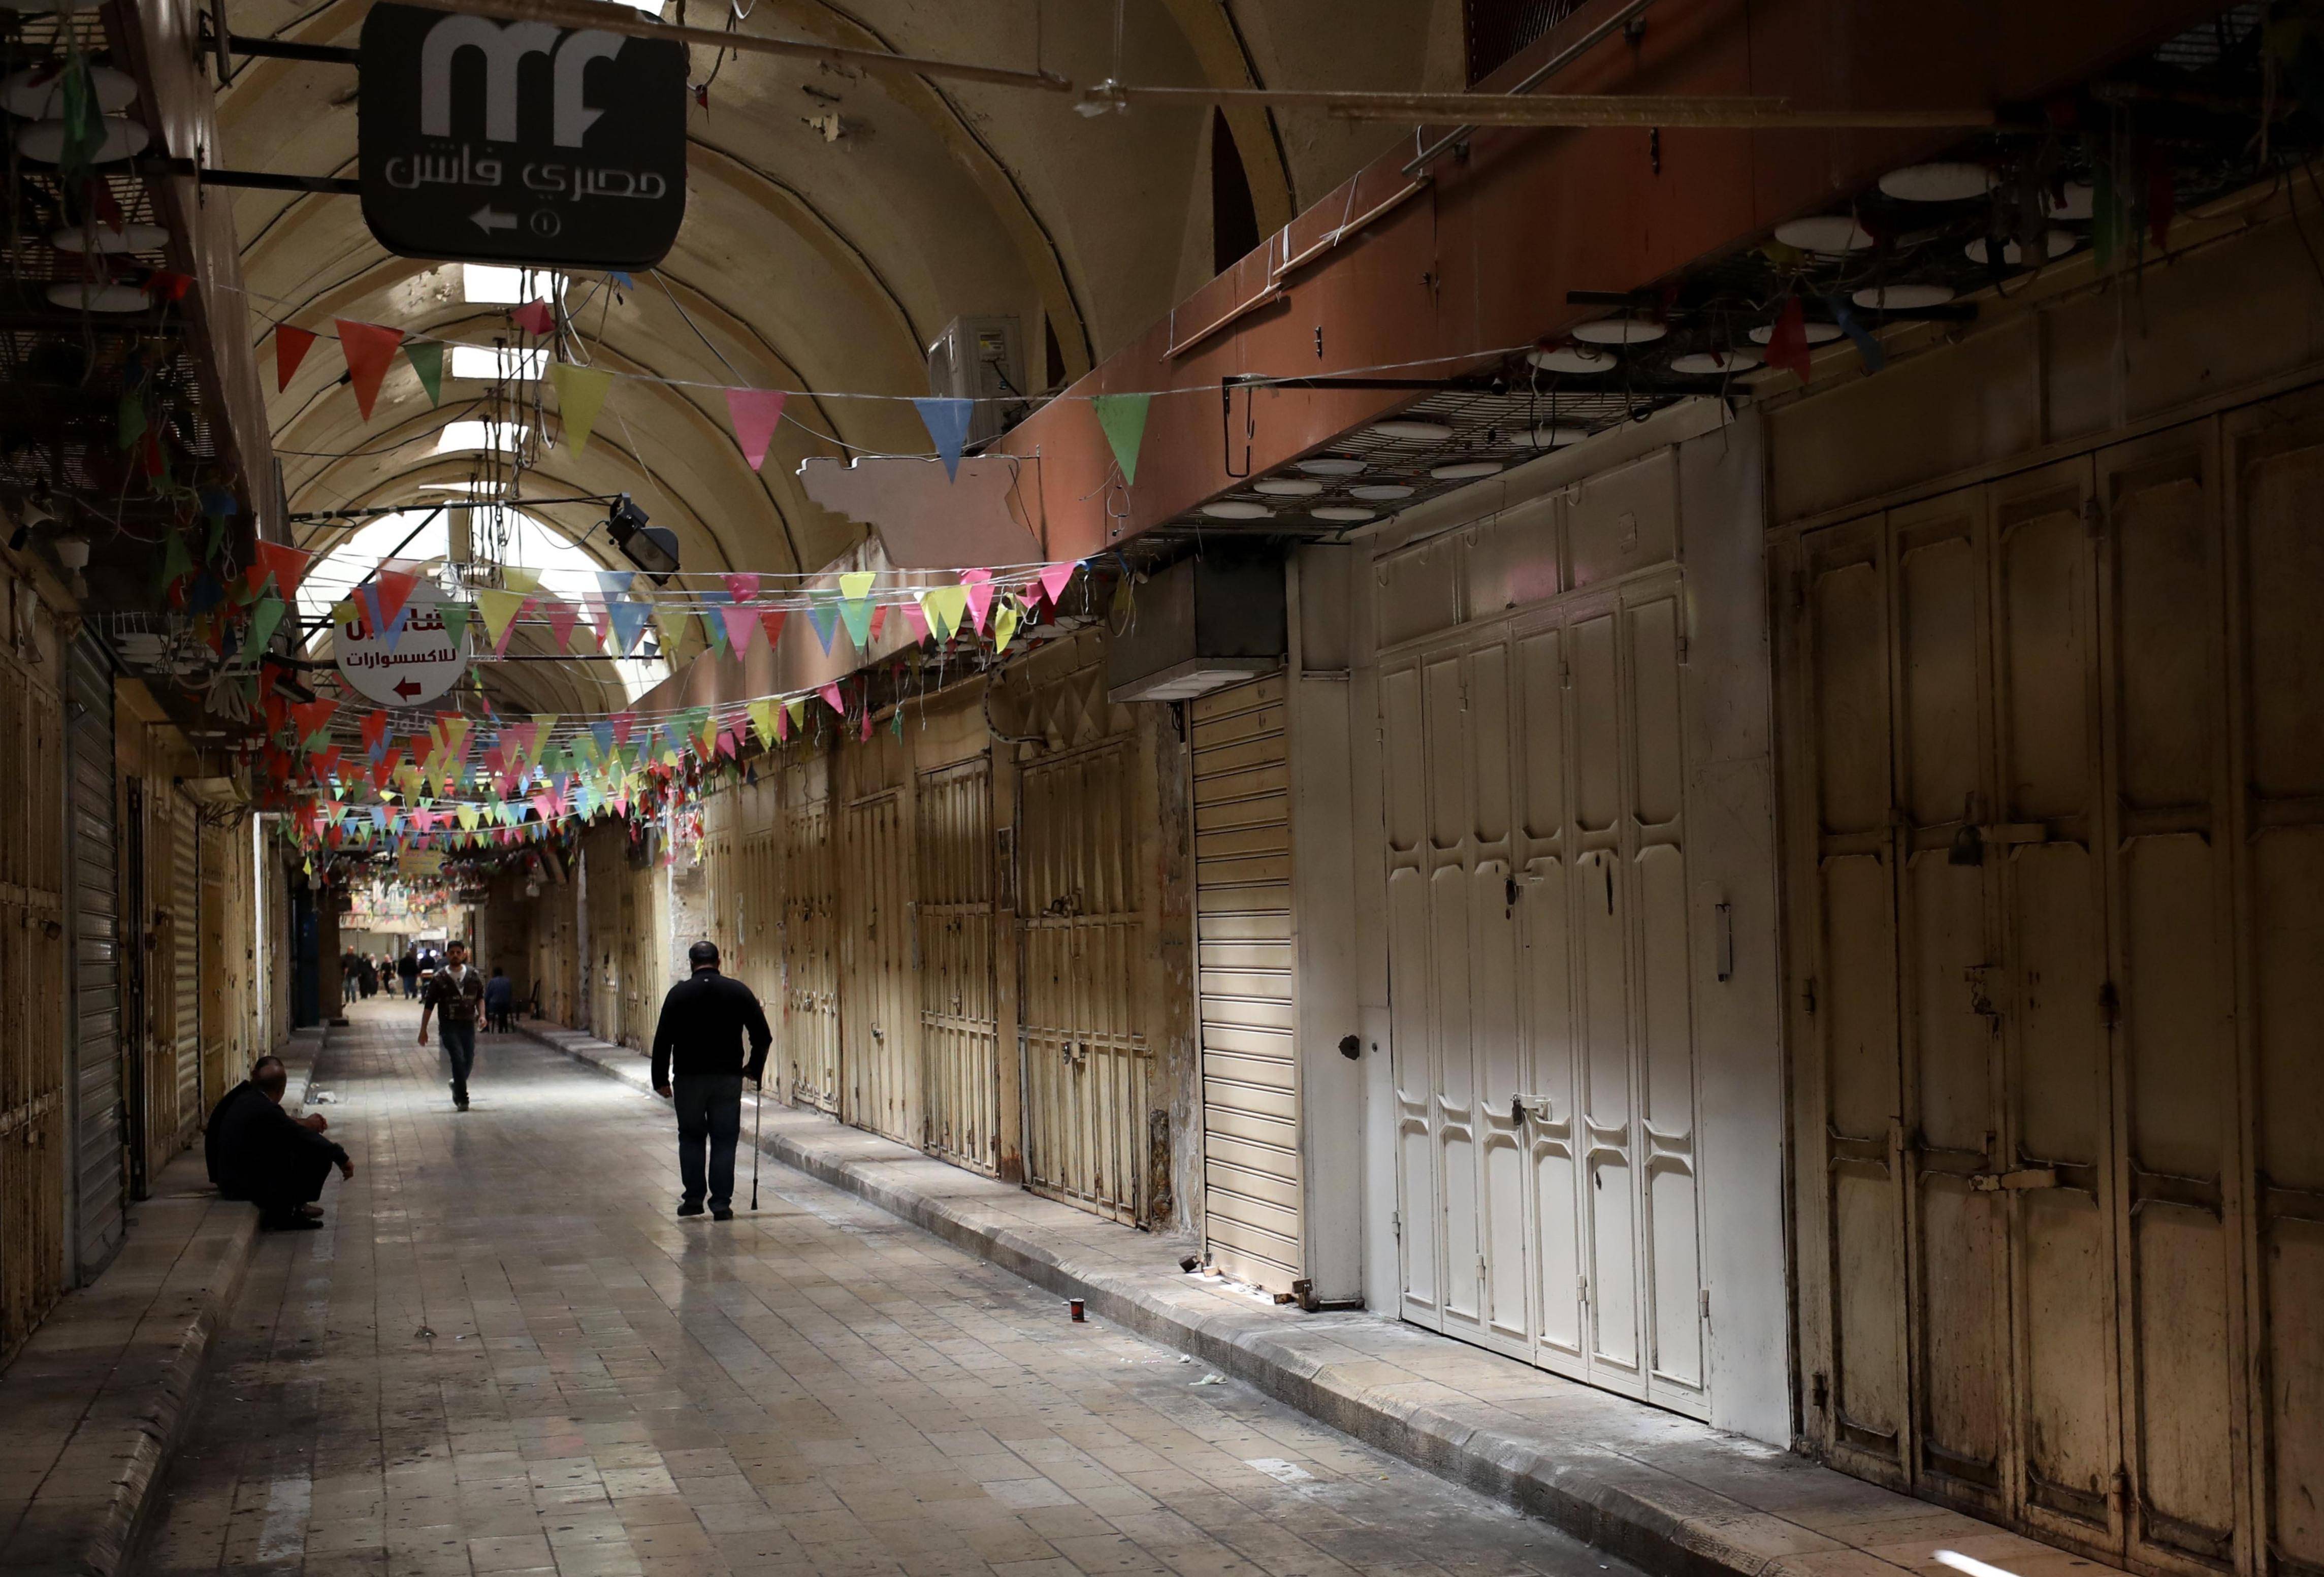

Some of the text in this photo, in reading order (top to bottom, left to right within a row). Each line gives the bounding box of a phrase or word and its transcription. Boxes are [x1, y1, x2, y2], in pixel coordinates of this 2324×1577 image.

[385, 143, 666, 202] مصري فاشن
[346, 648, 456, 669] للاكسسوارات
